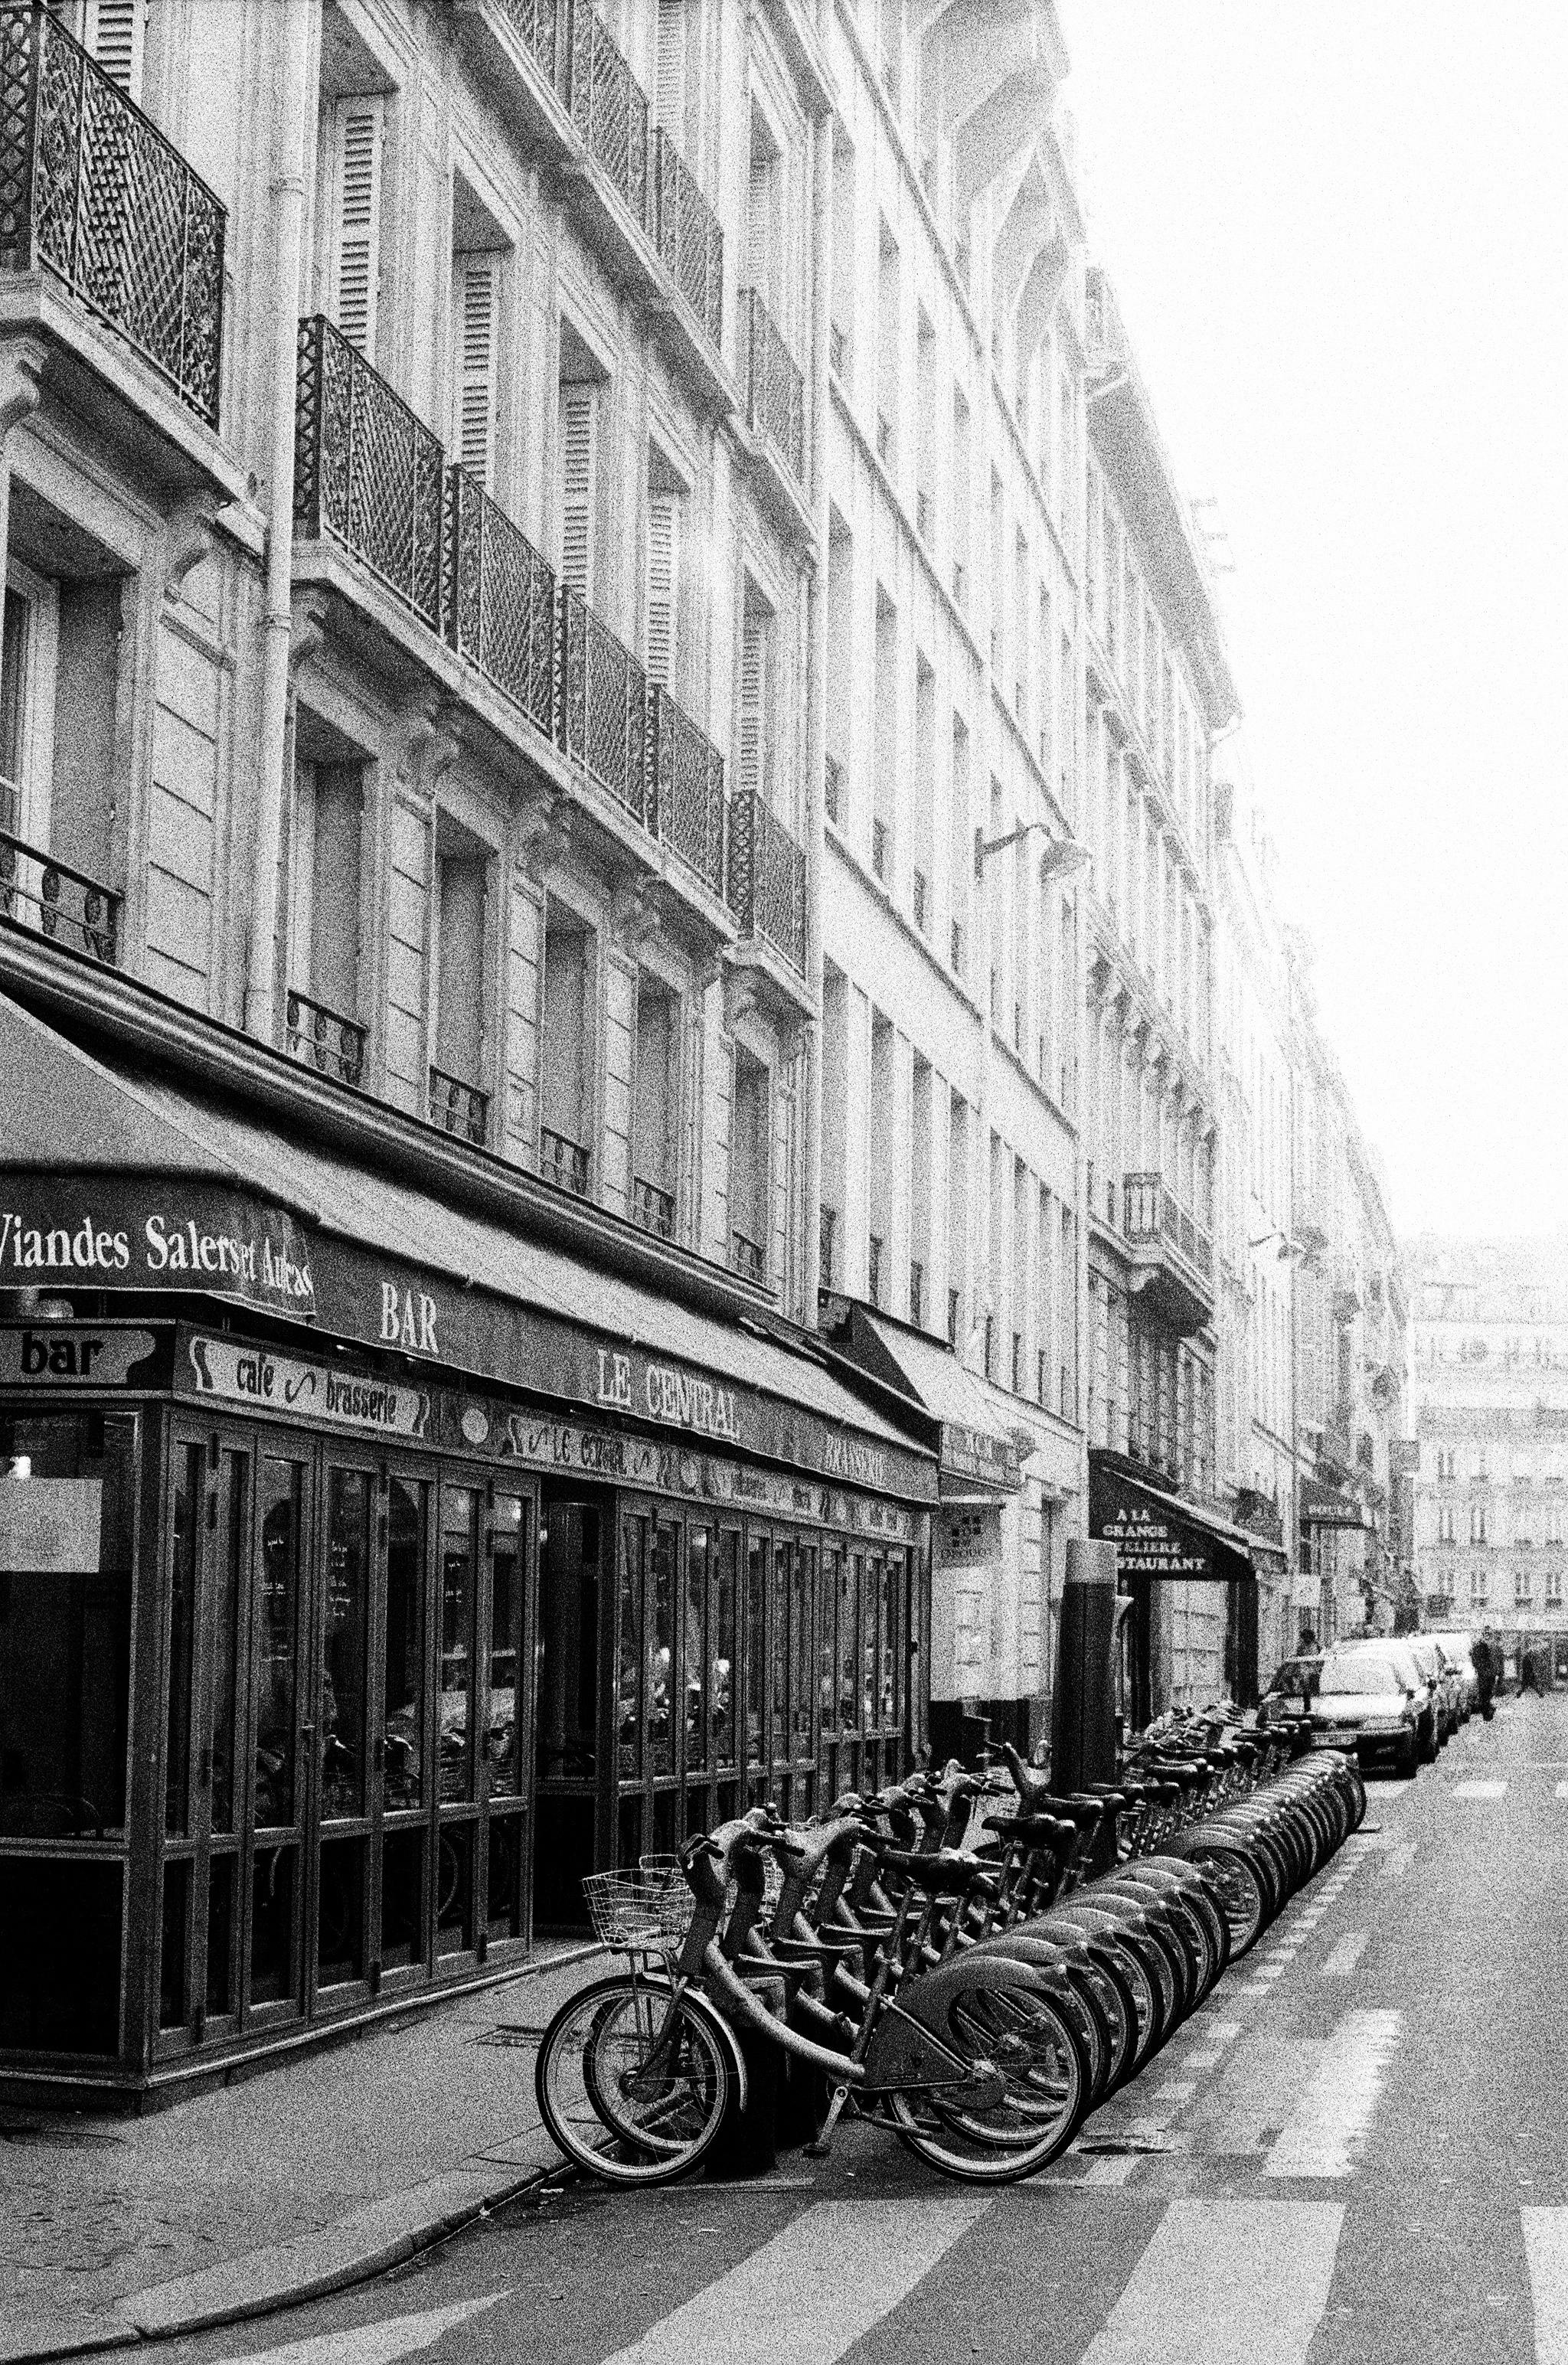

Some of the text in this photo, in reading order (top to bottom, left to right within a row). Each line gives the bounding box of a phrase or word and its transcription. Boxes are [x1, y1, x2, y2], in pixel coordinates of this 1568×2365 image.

[146, 1216, 239, 1273] Salers
[380, 1282, 439, 1354] BAR
[21, 1331, 104, 1376] bar
[326, 1370, 397, 1424] brasserie
[598, 1349, 740, 1439] LE CENTRAL
[1116, 1508, 1151, 1522] A LA
[1116, 1557, 1207, 1570] STAURANT
